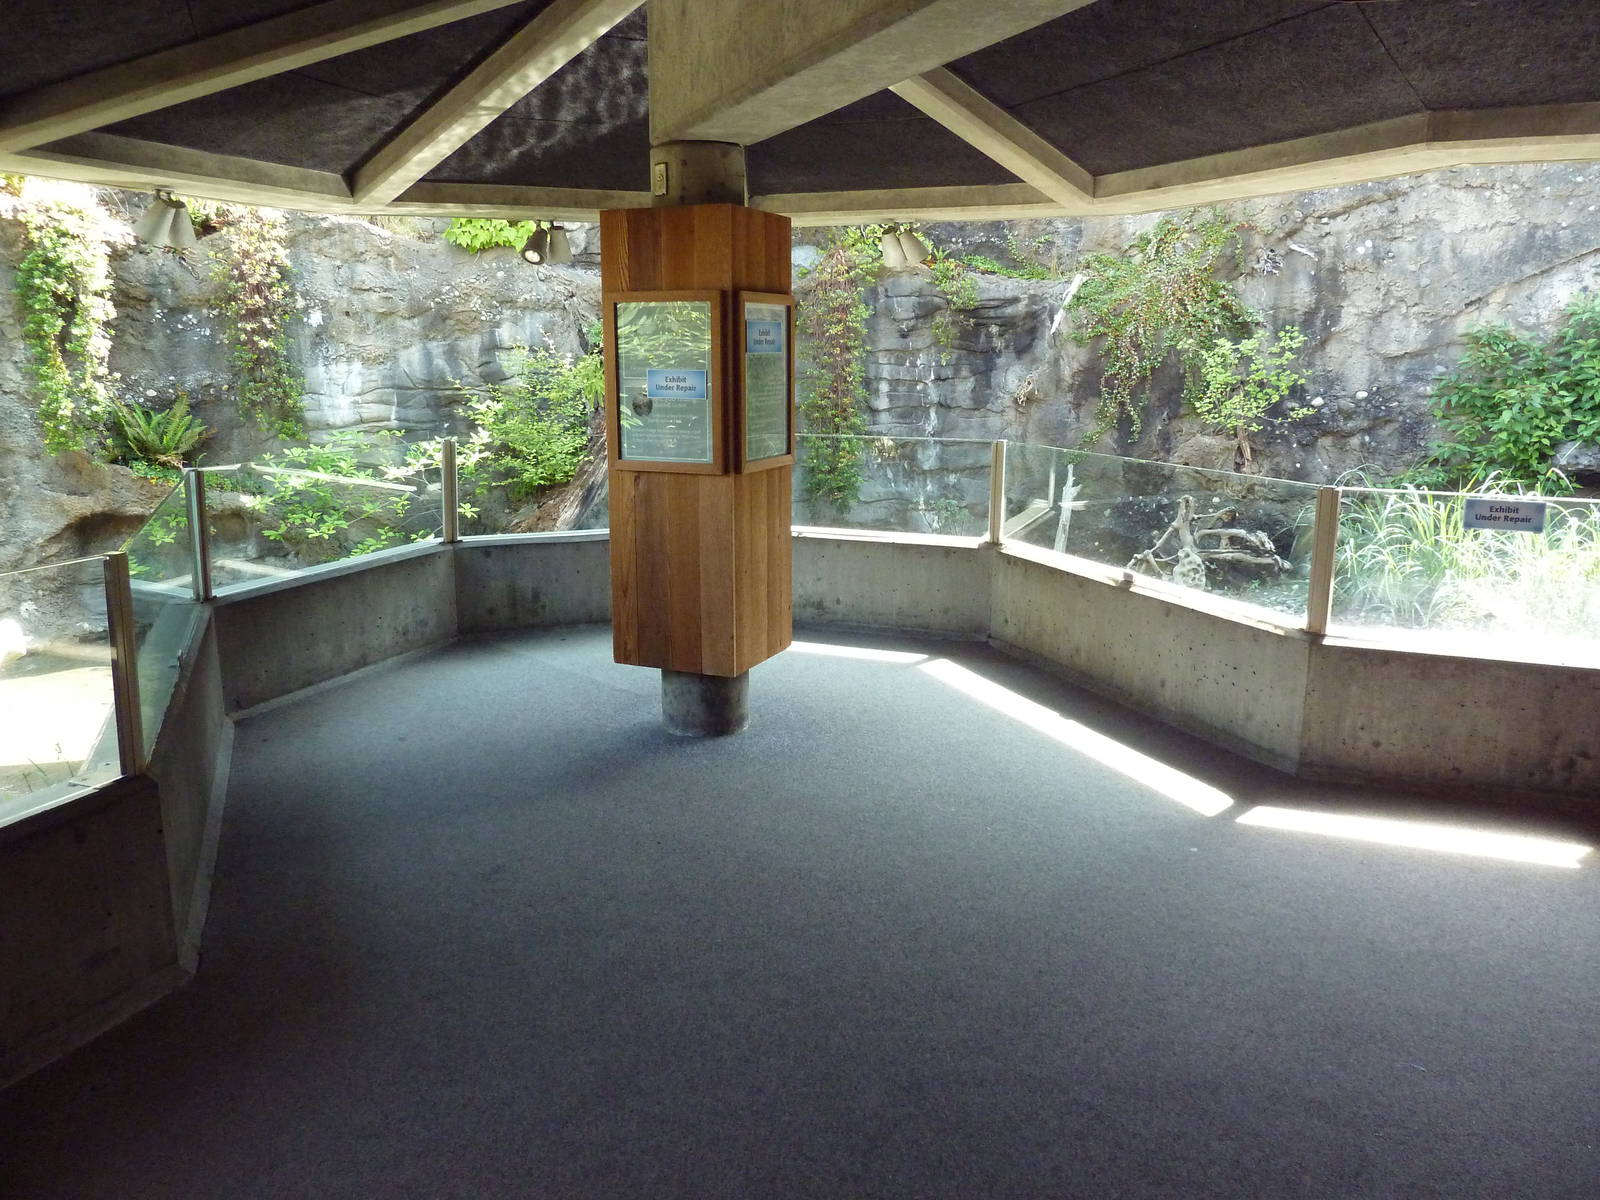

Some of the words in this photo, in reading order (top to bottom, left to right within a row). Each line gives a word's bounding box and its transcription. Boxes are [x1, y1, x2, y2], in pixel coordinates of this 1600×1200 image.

[664, 375, 688, 384] Exhibit
[655, 383, 675, 391] Under
[676, 384, 697, 393] Repair
[1489, 505, 1520, 514] Exhibit
[1475, 513, 1502, 522] Under
[1503, 514, 1532, 524] Repair
